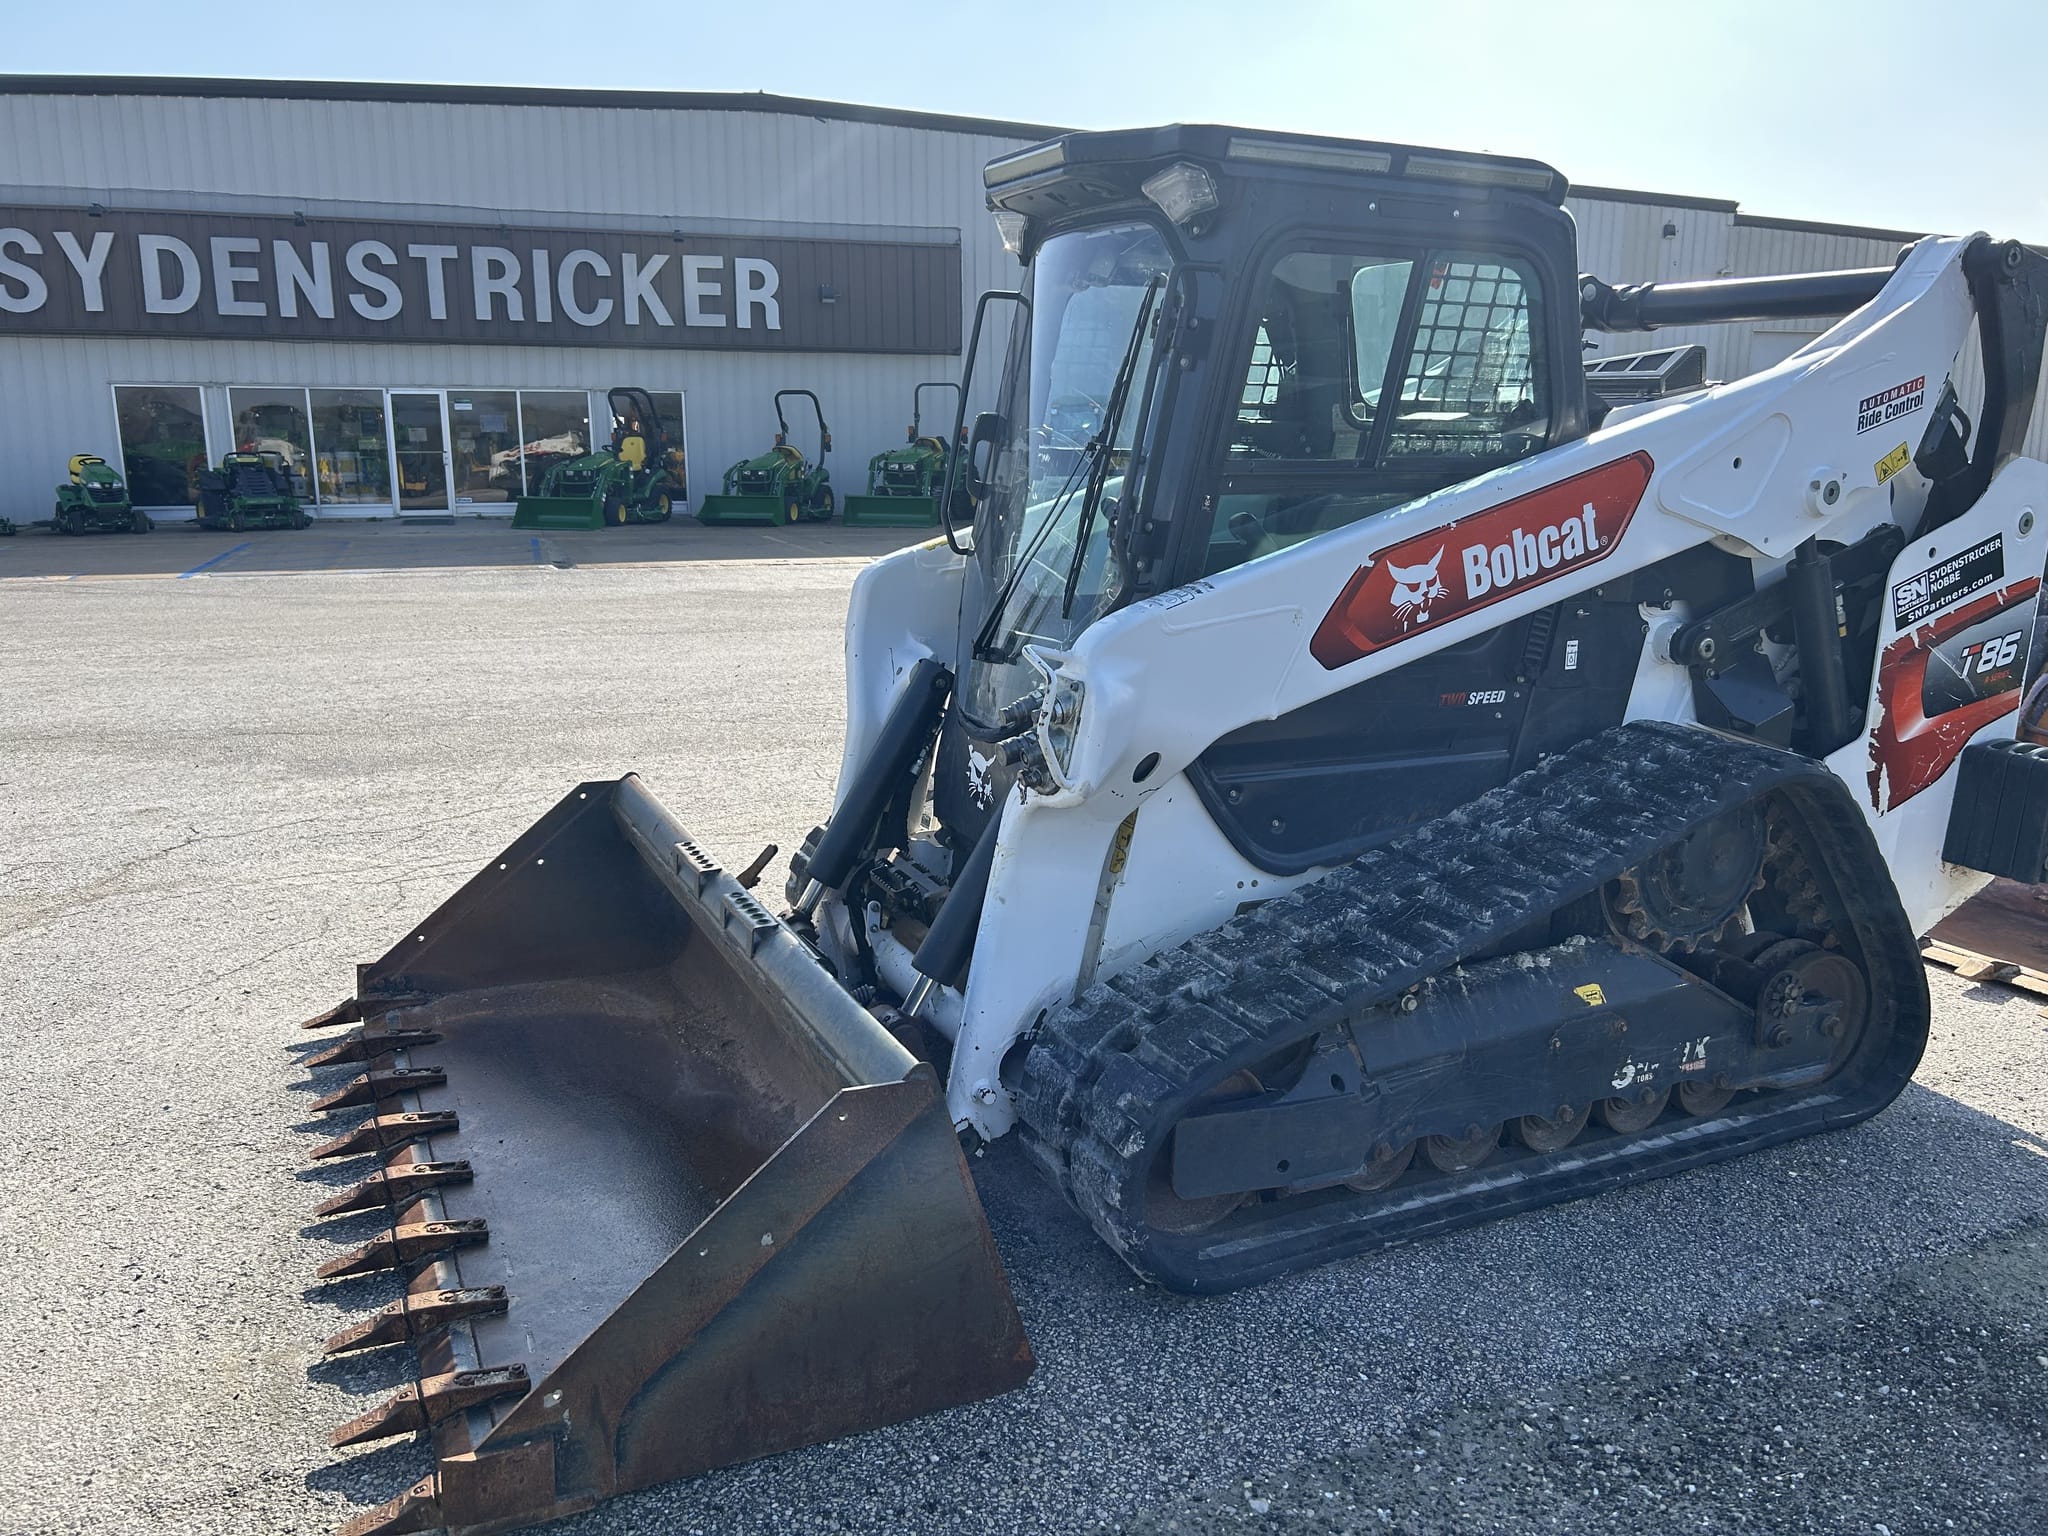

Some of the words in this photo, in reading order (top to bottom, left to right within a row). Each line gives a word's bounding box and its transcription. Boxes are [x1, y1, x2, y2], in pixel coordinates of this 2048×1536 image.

[0, 227, 782, 331] SYDENSTRICKER
[1857, 410, 1882, 431] Ride
[1885, 390, 1924, 420] Control
[1861, 378, 1924, 411] AUTOMATIC
[1462, 502, 1600, 600] Bobcat
[1929, 539, 2002, 582] SYDENSTRICKER
[1908, 574, 1993, 622] SNPartners.com
[1930, 571, 1961, 593] NOBBE
[1467, 690, 1506, 705] SPEED
